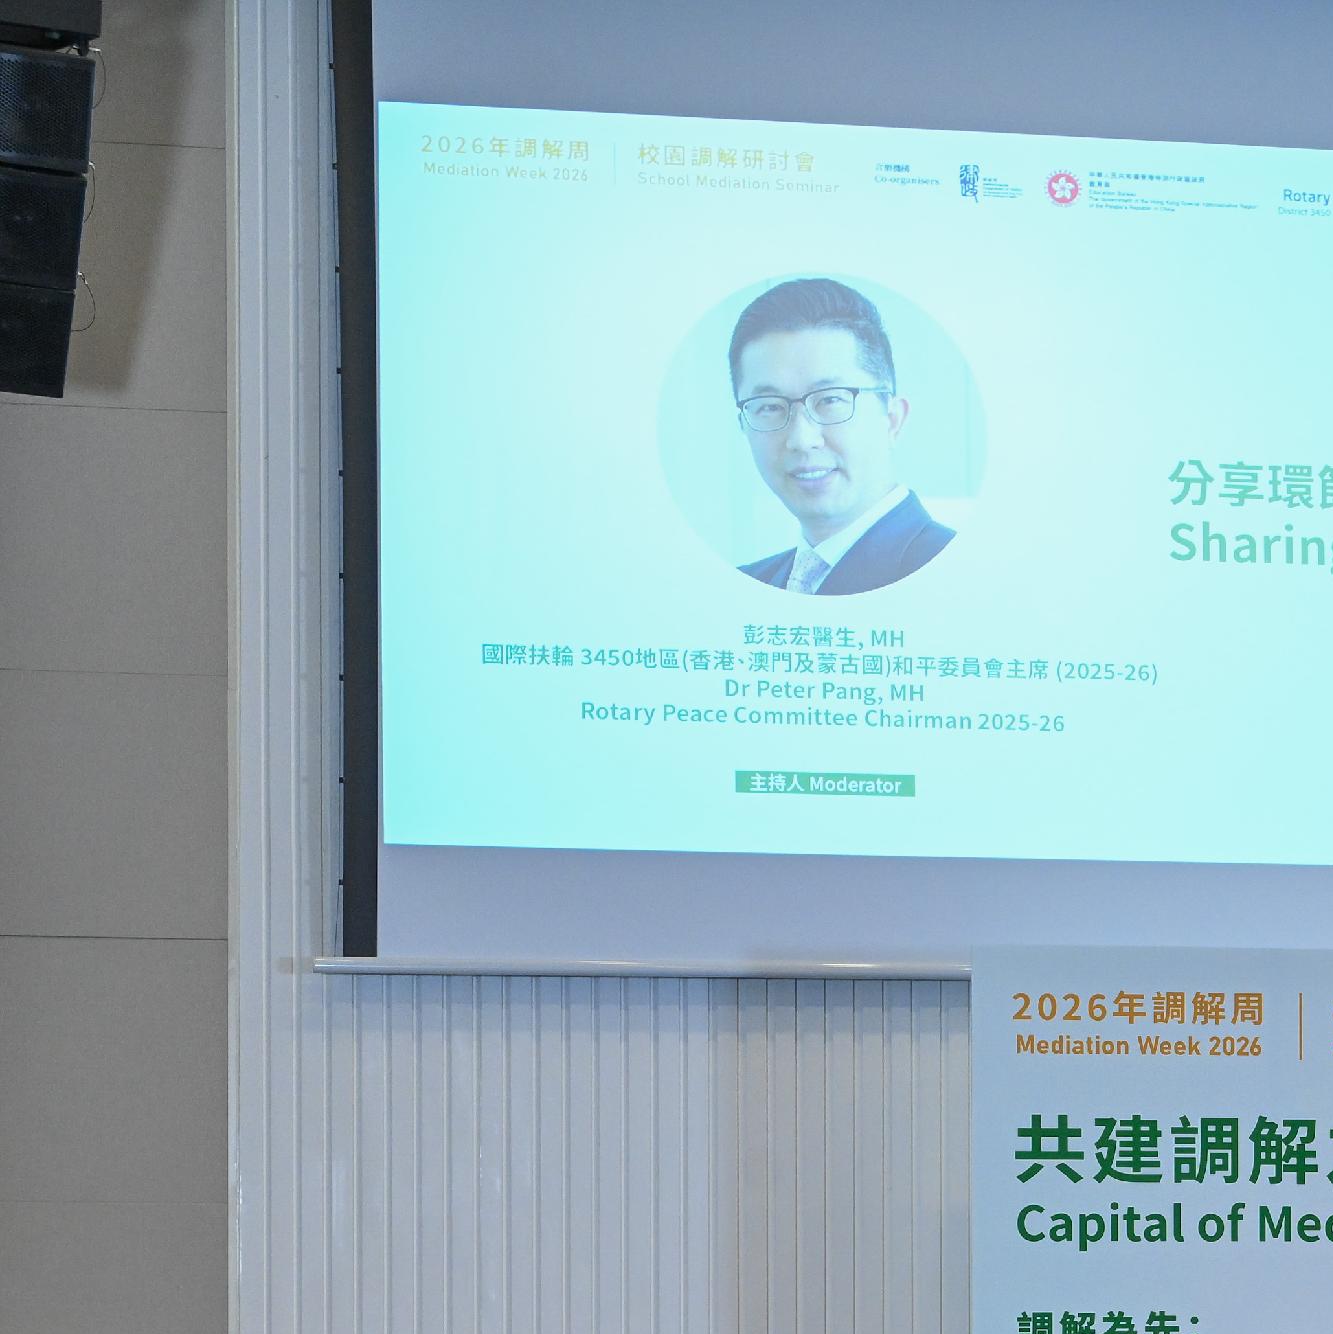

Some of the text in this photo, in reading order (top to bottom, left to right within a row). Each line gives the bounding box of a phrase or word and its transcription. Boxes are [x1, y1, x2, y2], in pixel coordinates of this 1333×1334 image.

[421, 135, 588, 161] 2026年調解周
[638, 143, 814, 172] 校園調解研討會
[424, 162, 587, 181] Mediation Week 2026
[638, 172, 840, 192] School Mediation Seminar
[1283, 189, 1331, 206] Rotary
[744, 624, 903, 650] 彭志宏醫生, MH
[482, 644, 573, 666] 國際扶輪
[1057, 661, 1157, 685] (2025-26)
[726, 679, 923, 705] Dr Peter Pang, MH
[582, 702, 1064, 731] Rotary Peace Committee Chairman 2025-26
[749, 772, 902, 795] 主持人 Moderator
[1013, 991, 1263, 1025] 2026年調解周
[1016, 1034, 1261, 1056] Mediation Week 2026
[1017, 1202, 1184, 1251] Capital
[1198, 1203, 1245, 1242] of
